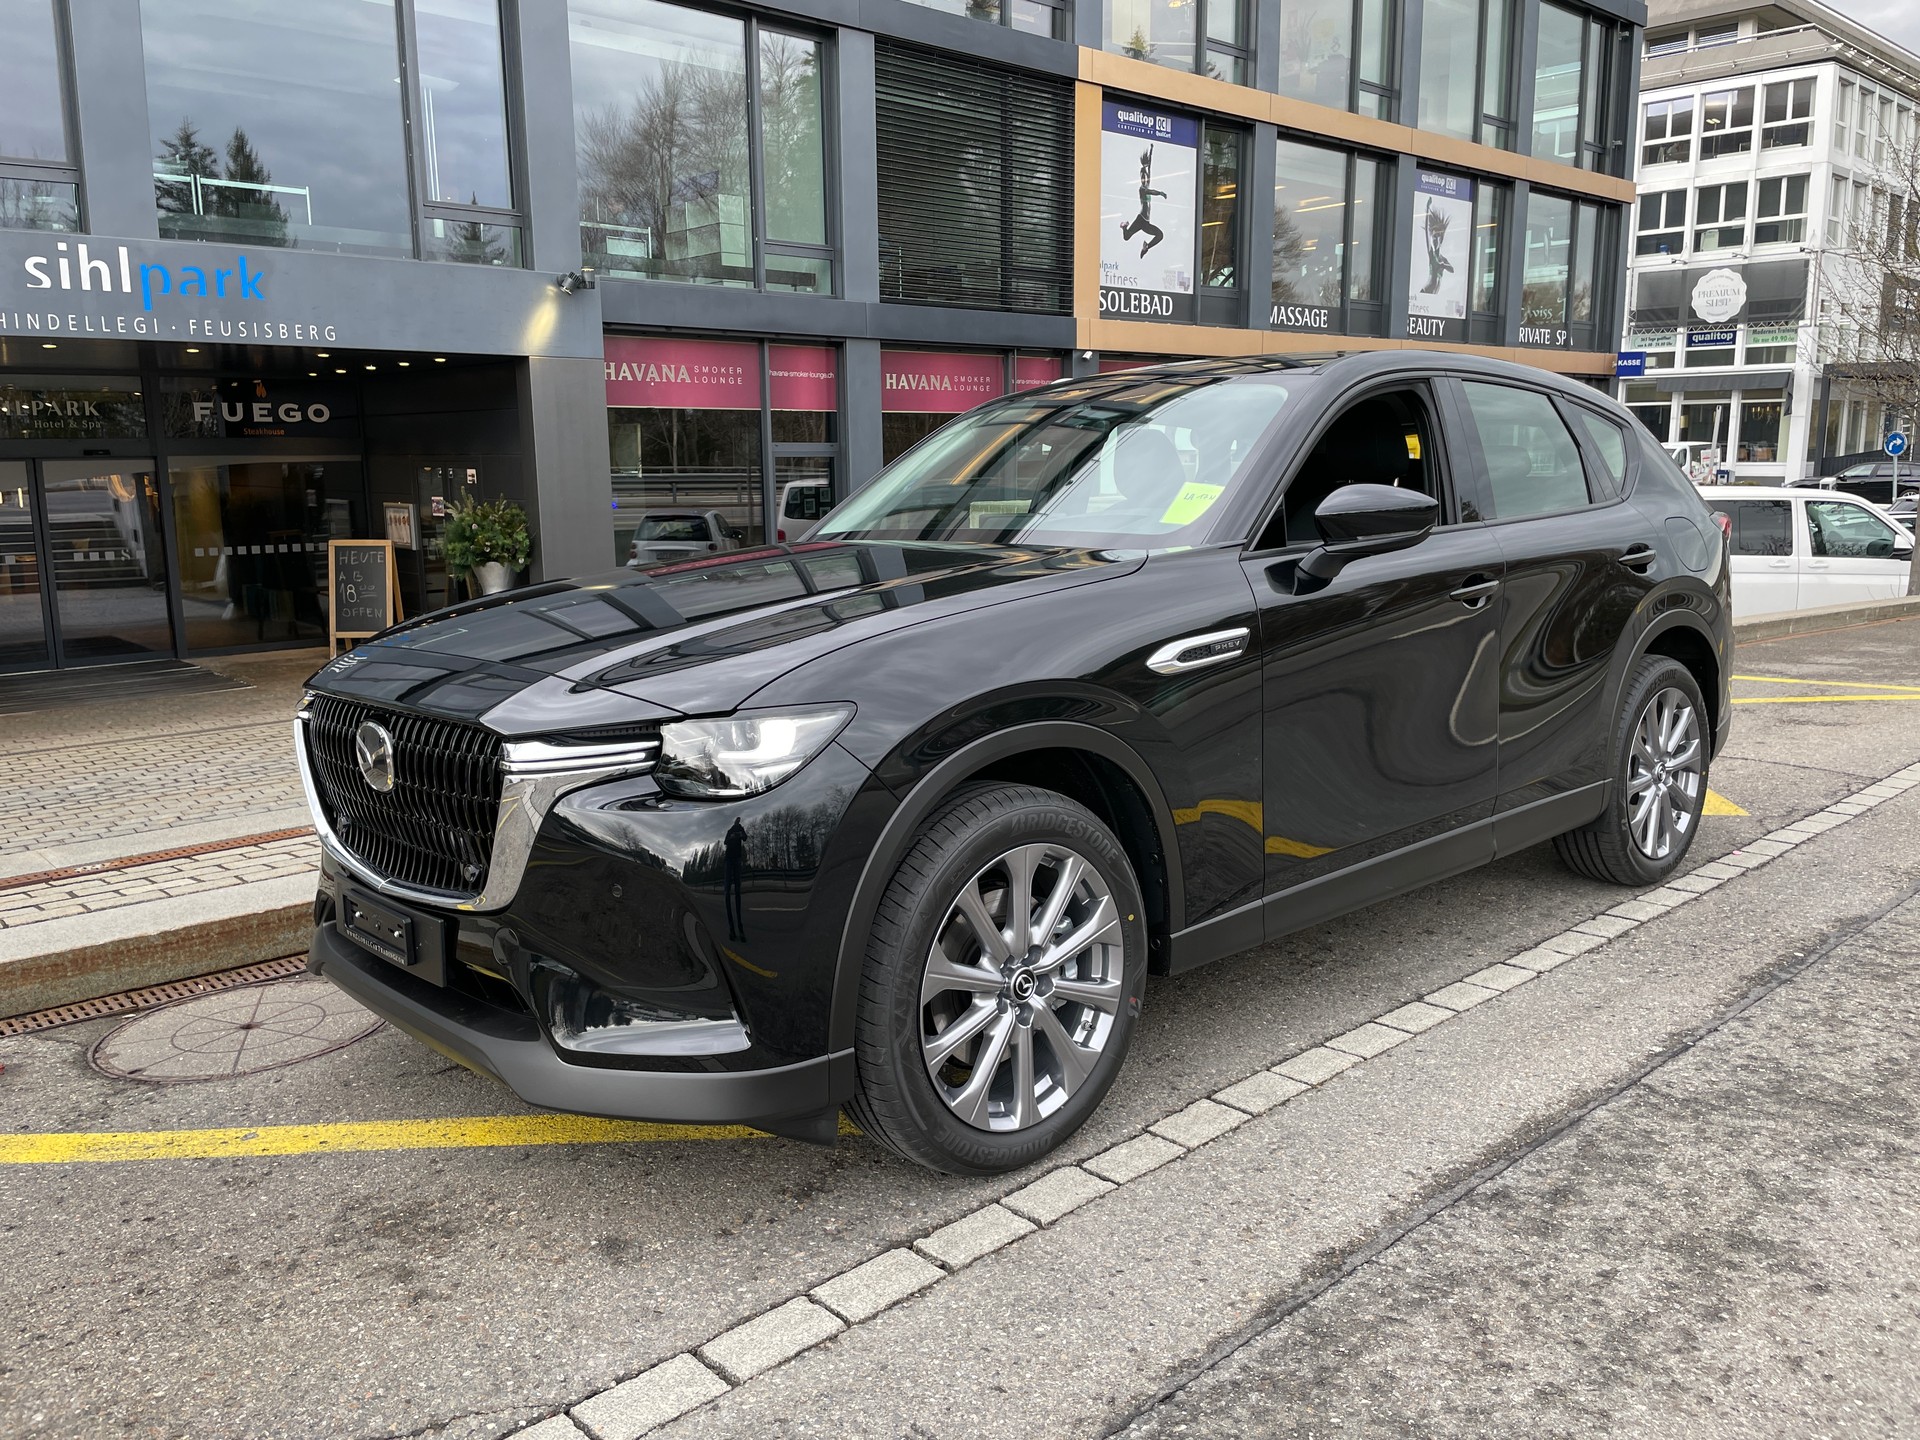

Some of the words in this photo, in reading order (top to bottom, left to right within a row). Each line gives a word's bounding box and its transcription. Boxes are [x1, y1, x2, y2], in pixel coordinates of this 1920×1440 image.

[1117, 110, 1154, 128] qualitop
[1421, 174, 1446, 187] qualitop
[24, 242, 266, 311] sihlpark
[1105, 271, 1138, 287] fitness
[1698, 288, 1740, 298] PREMIUM
[1099, 289, 1173, 316] SOLEBAD
[189, 319, 337, 341] FEUSISBERG
[1407, 317, 1446, 337] EAUTY
[1555, 329, 1574, 346] SP
[1692, 332, 1733, 343] qualitop
[1617, 359, 1641, 367] KASSE
[604, 362, 692, 383] HAVANA
[693, 365, 743, 375] SMOKER
[769, 370, 835, 380] havana-smoker-lounge.ch
[693, 376, 743, 385] LOUNGE
[885, 373, 952, 391] HAVANA
[953, 375, 992, 383] SMOKER
[953, 384, 991, 392] LOUNGE
[192, 401, 330, 423] FUEGO
[34, 420, 65, 429] Hotel
[69, 420, 78, 429] &
[82, 420, 102, 430] Spa
[243, 427, 285, 436] Steakhouse
[339, 550, 384, 565] HEUTE
[342, 607, 383, 618] OFFEN
[1215, 640, 1240, 651] PHEV
[1009, 812, 1119, 864] BRIDGESTONE
